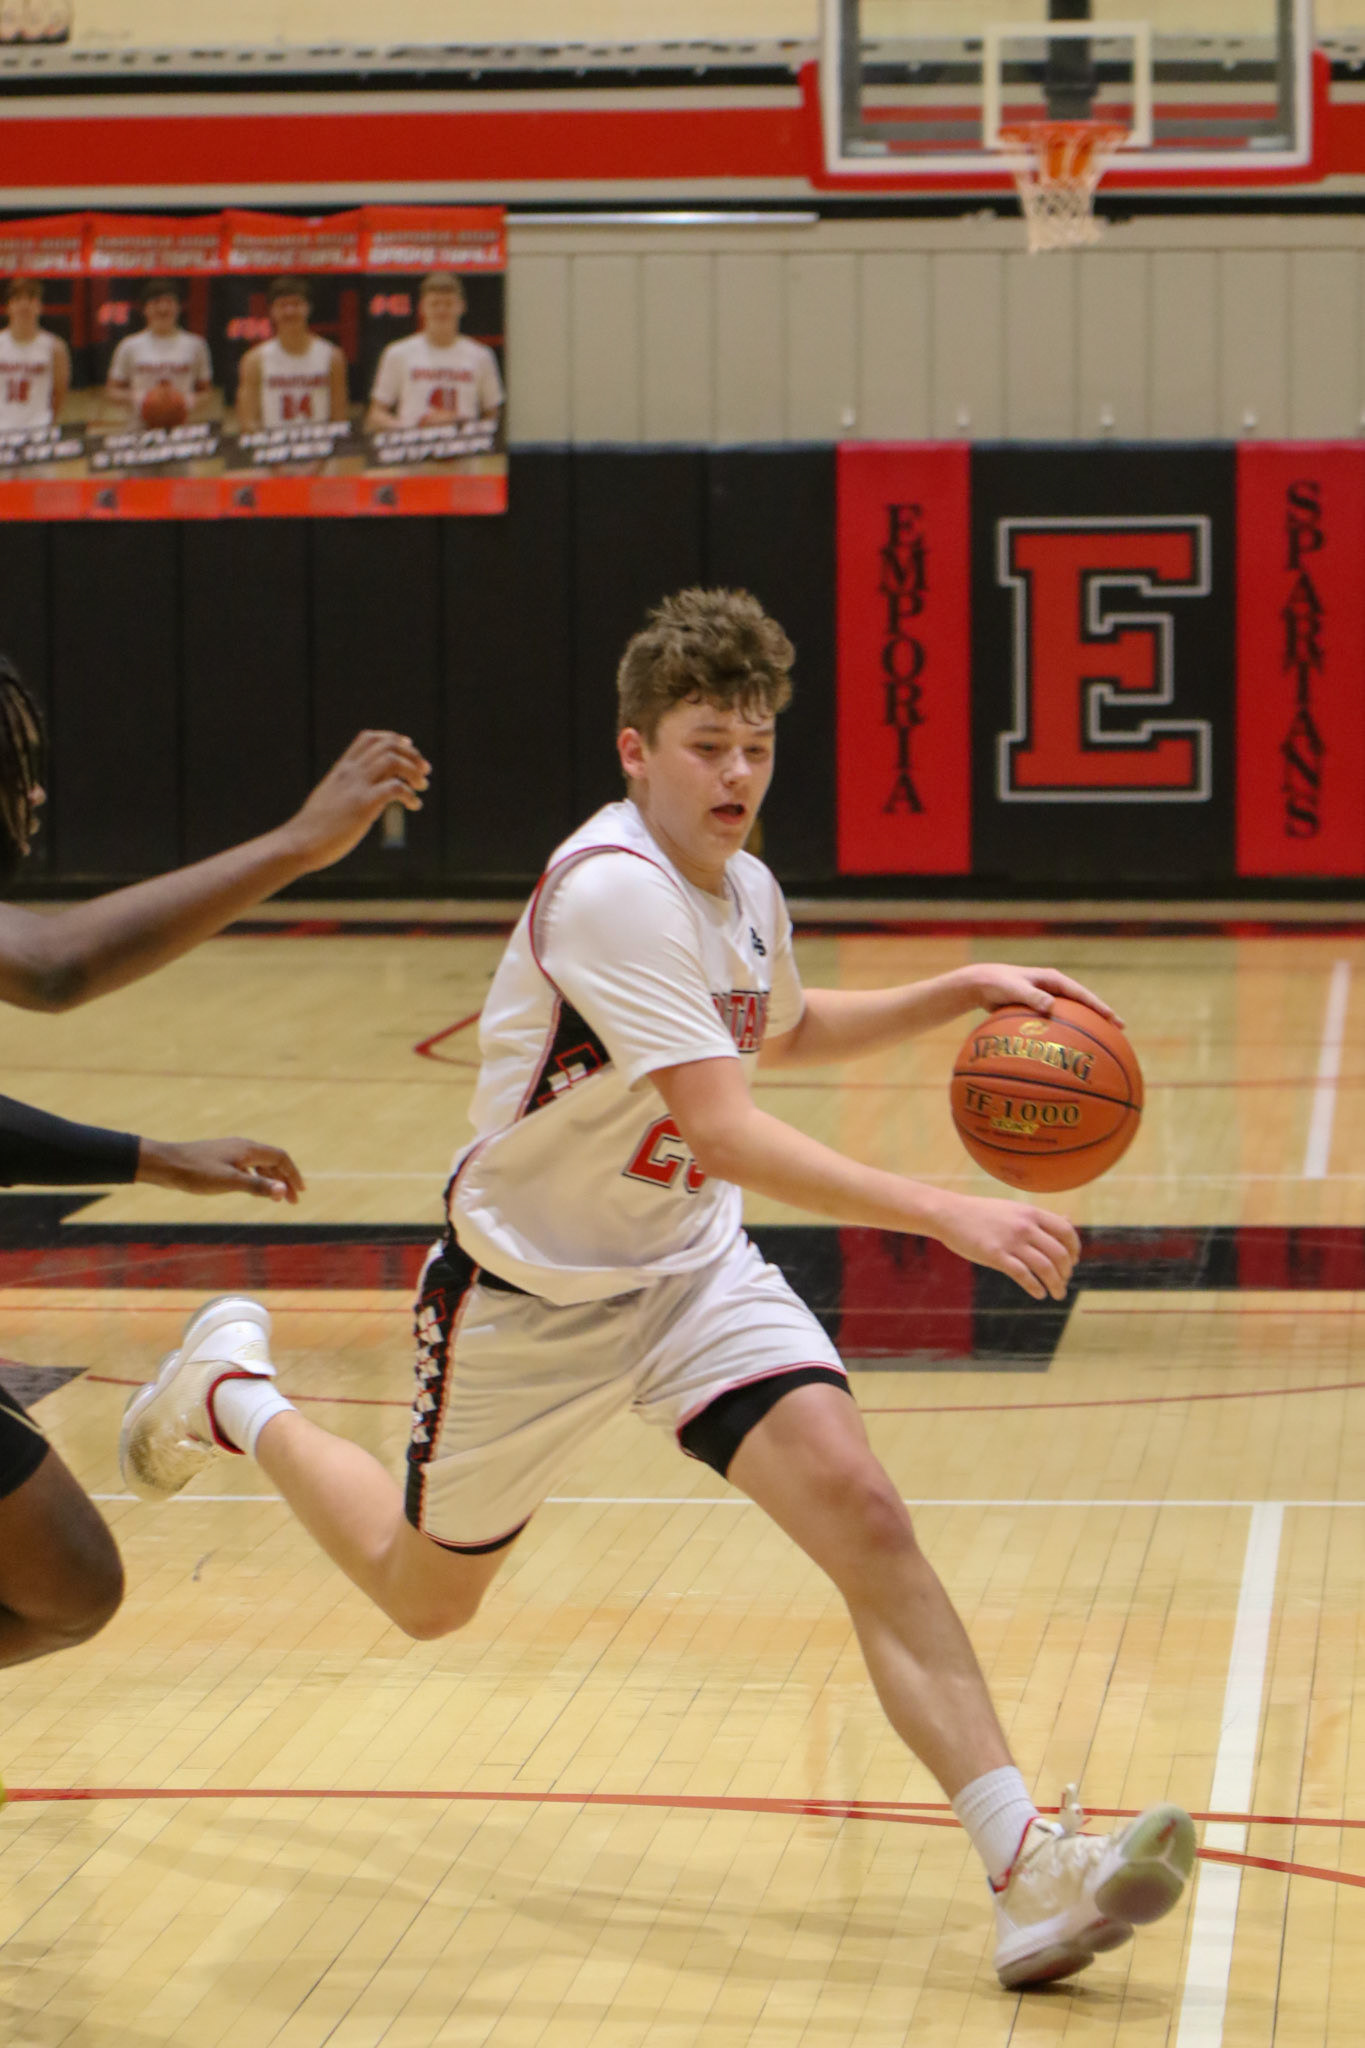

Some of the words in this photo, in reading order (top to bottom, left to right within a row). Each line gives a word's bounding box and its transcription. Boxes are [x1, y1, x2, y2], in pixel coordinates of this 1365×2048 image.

[879, 502, 929, 815] EMPORIA
[996, 515, 1212, 802] E
[1282, 480, 1326, 839] SPARTANS
[969, 1035, 1095, 1083] SPALDING
